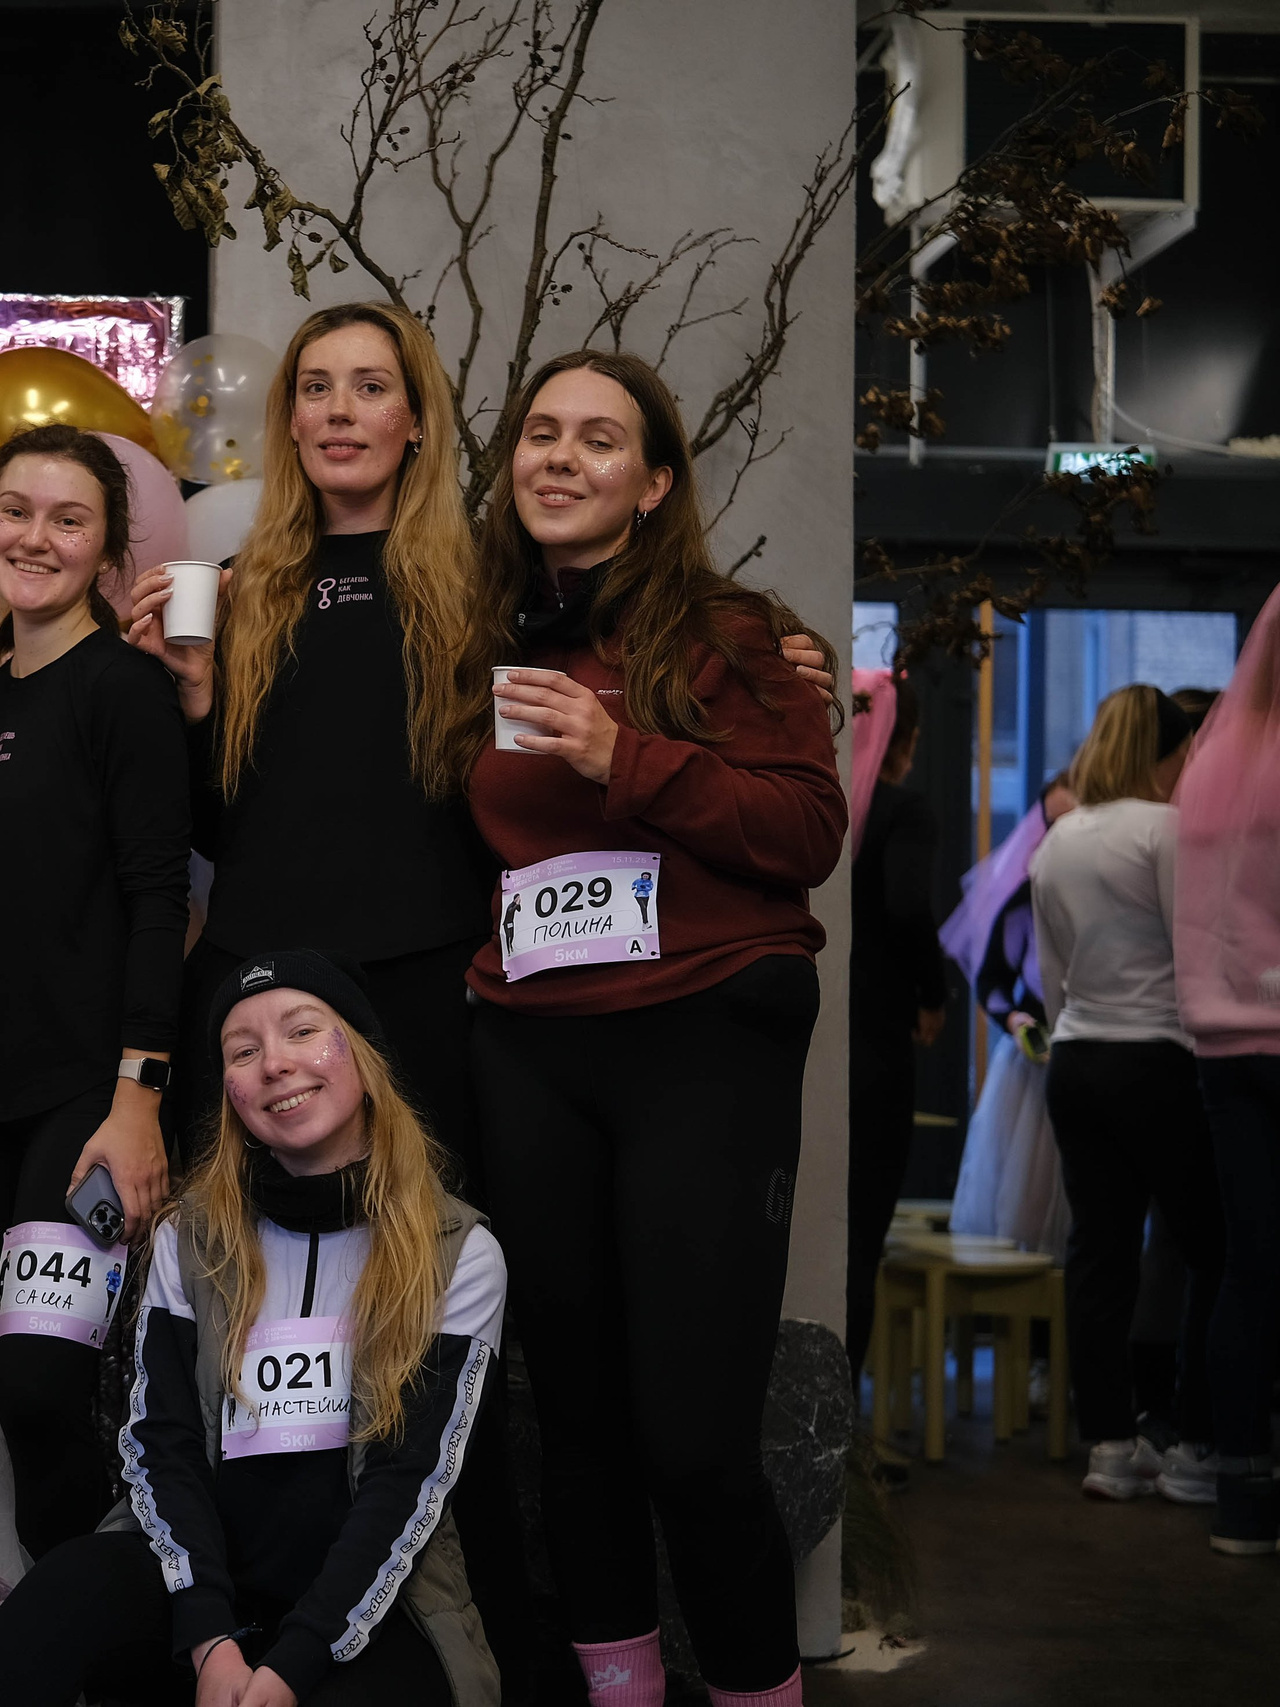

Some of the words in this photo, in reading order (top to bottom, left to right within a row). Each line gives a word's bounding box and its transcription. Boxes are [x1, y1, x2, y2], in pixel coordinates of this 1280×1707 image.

[337, 593, 373, 604] ДЕВЧОНКА
[339, 576, 369, 584] БЕГАЕШЬ
[535, 877, 612, 918] 029
[533, 914, 613, 944] ПОЛИНА
[16, 1250, 92, 1288] 044
[15, 1289, 74, 1310] САША
[257, 1351, 332, 1392] 021
[464, 1349, 486, 1405] Kappa
[438, 1431, 461, 1484] Kappa
[400, 1505, 435, 1553] Kappa
[360, 1571, 396, 1621] Kappa
[332, 1634, 361, 1661] Kap
